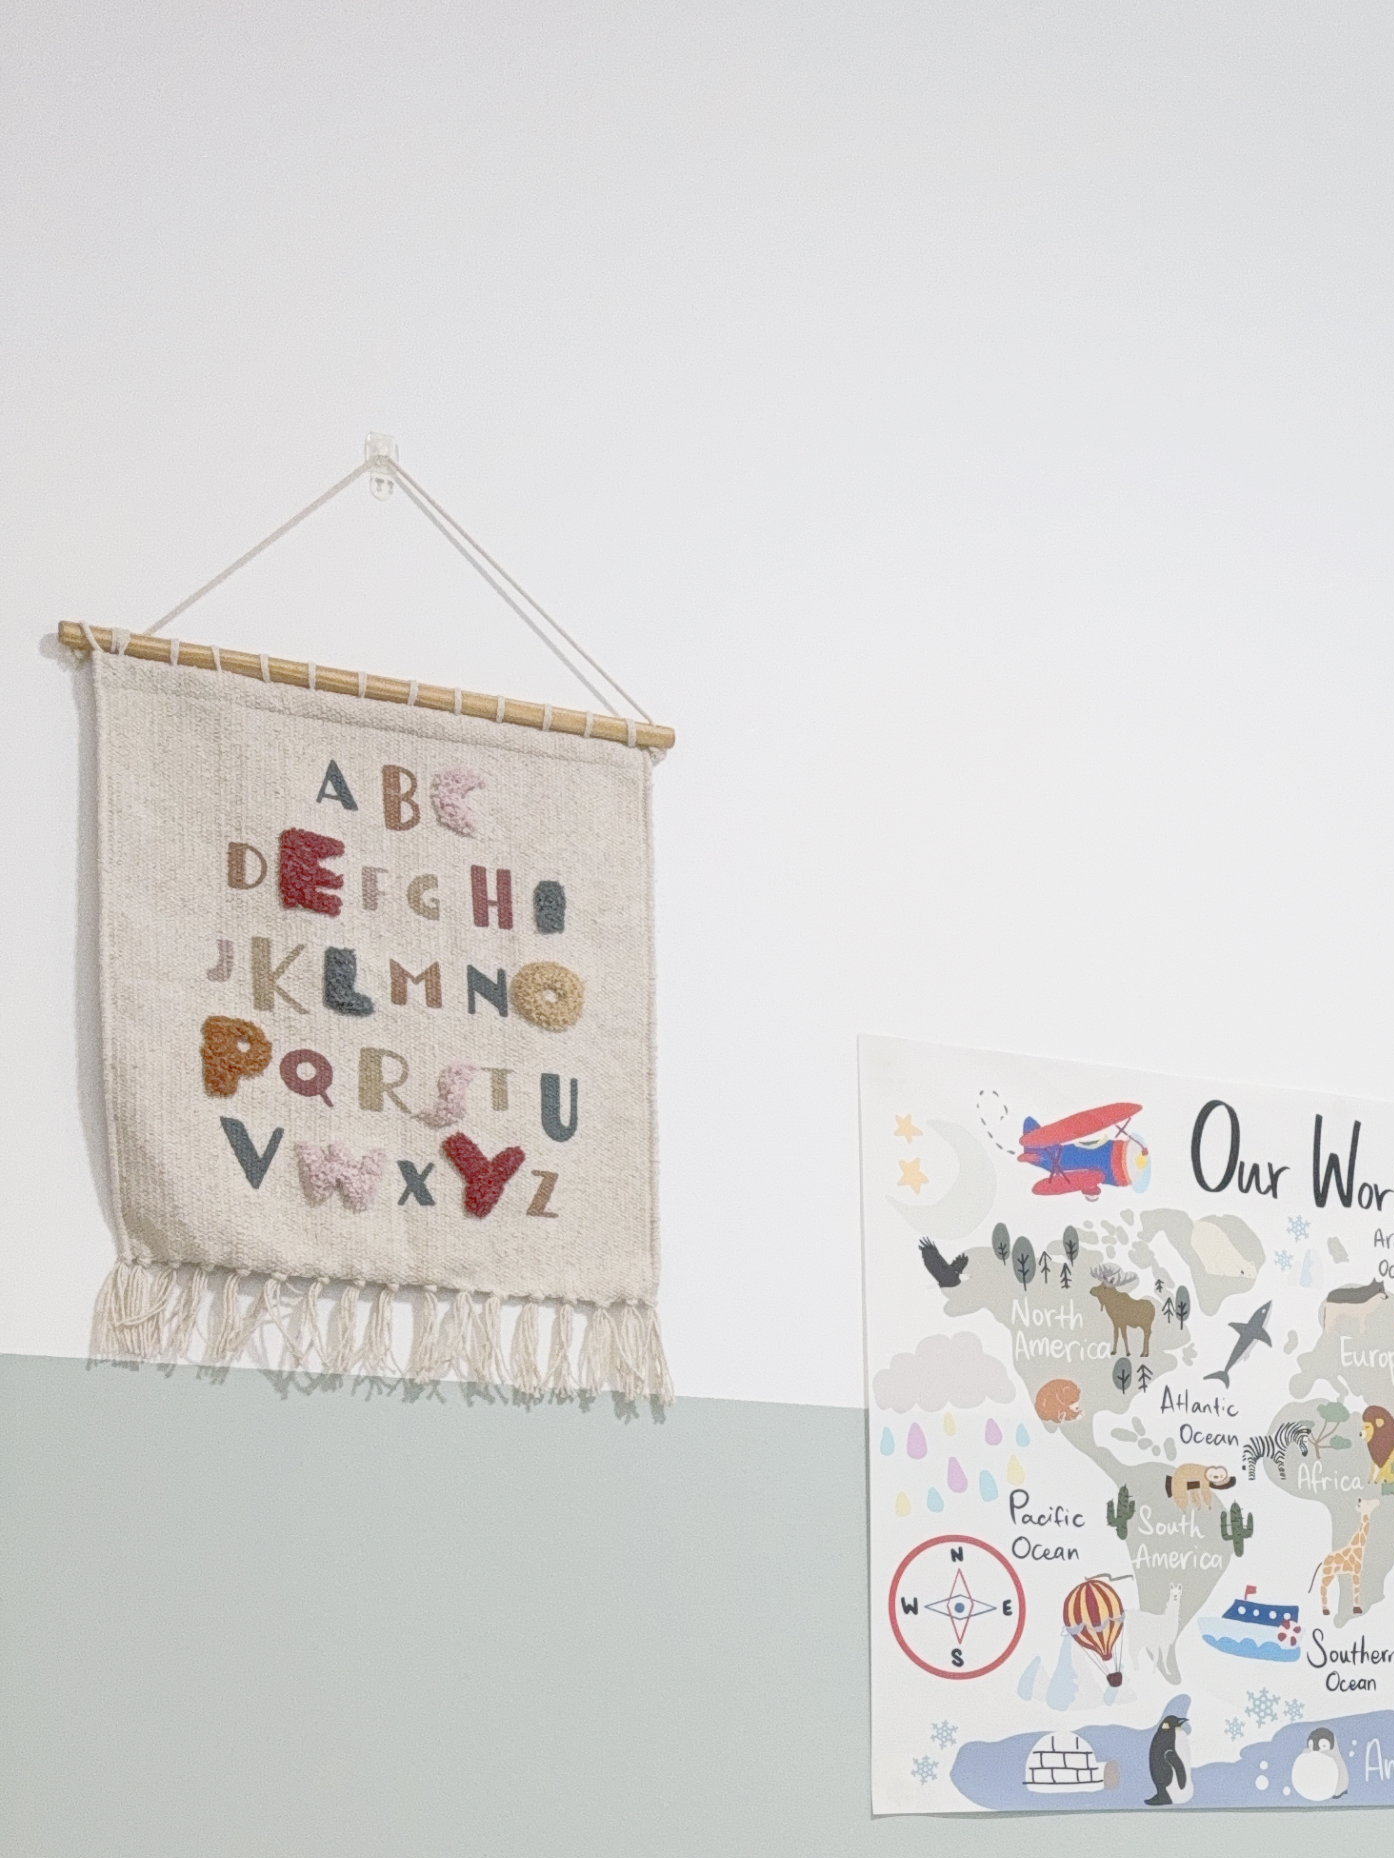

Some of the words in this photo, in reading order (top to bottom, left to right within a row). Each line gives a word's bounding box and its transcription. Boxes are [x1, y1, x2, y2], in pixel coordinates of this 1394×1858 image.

[1191, 1100, 1290, 1199] Our
[1012, 1299, 1084, 1329] North
[1015, 1331, 1112, 1360] America
[1160, 1385, 1239, 1417] Atlantic
[1180, 1424, 1239, 1446] Ocean
[1297, 1463, 1365, 1491] Africa
[1010, 1489, 1086, 1528] Pacific
[1139, 1505, 1205, 1539] South
[951, 1547, 964, 1562] N
[1012, 1537, 1079, 1561] Ocean
[1131, 1546, 1223, 1570] America
[901, 1597, 919, 1616] W
[1003, 1601, 1013, 1615] E
[951, 1649, 964, 1667] S
[1326, 1671, 1376, 1692] Ocean
